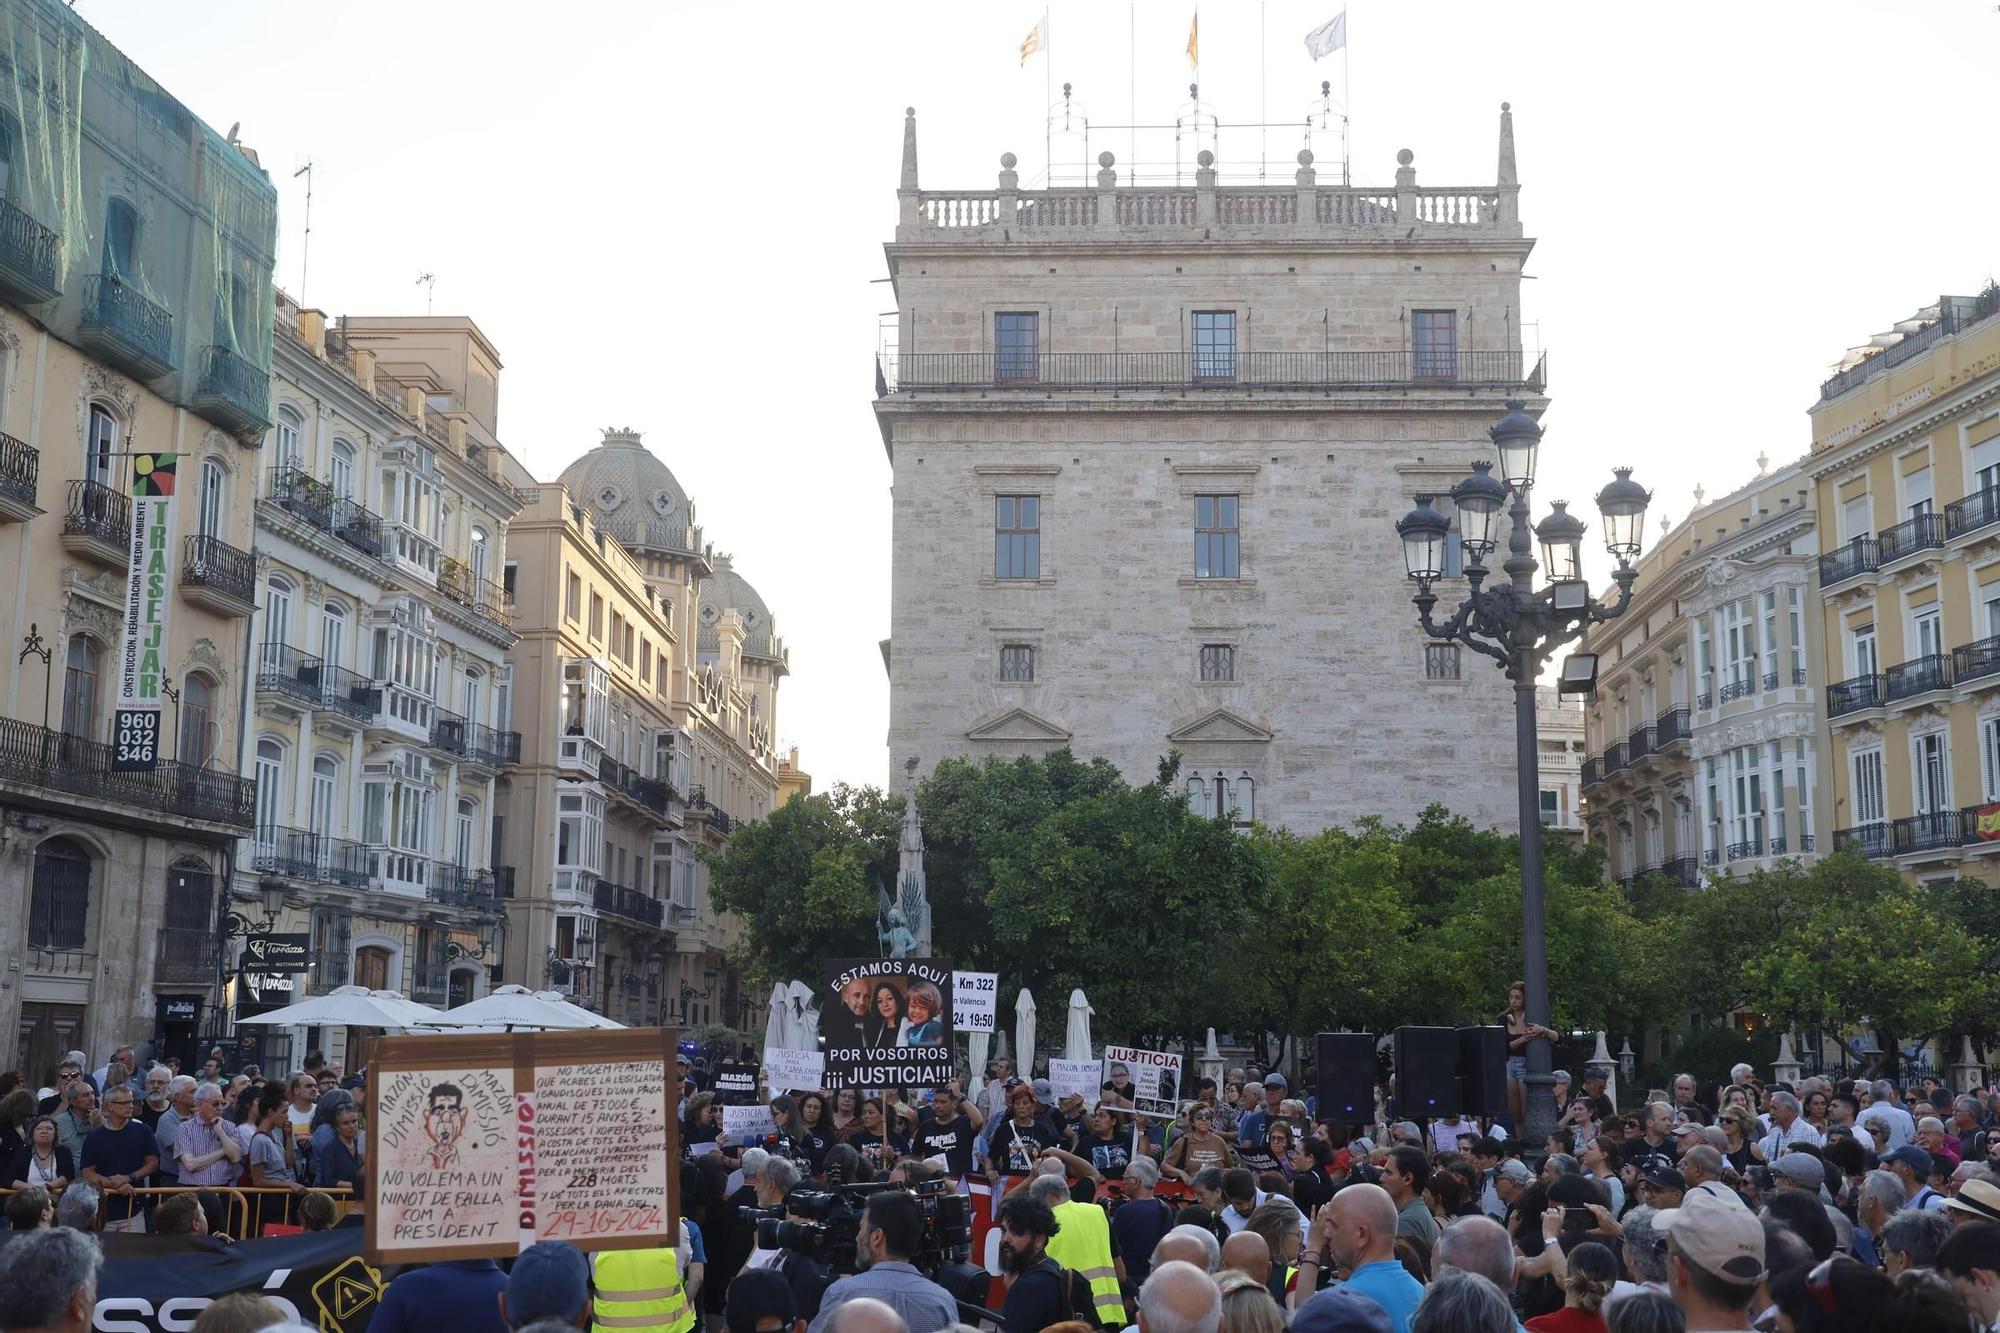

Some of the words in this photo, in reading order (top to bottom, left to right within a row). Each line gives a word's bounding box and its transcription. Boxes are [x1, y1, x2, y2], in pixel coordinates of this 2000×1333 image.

[134, 500, 146, 540] AMBIENTE
[133, 541, 144, 566] MEDIO
[132, 567, 141, 575] Y
[139, 501, 168, 698] TRASEJAR
[120, 712, 156, 729] 960
[119, 729, 154, 746] 032
[117, 745, 153, 762] 346
[266, 943, 305, 955] Terrazza
[830, 961, 902, 993] ESTAMOS
[907, 962, 949, 986] AQUÍ
[959, 977, 974, 990] Km
[976, 978, 994, 991] 322
[969, 1013, 993, 1027] 19:50
[776, 1050, 810, 1061] JUSTICIA
[830, 1049, 861, 1061] POR
[866, 1047, 948, 1061] VOSOTROS
[1107, 1048, 1180, 1069] JUSTICIA
[557, 1065, 572, 1076] NO
[576, 1064, 612, 1076] PODEM
[848, 1065, 952, 1085] JUSTICIA!!!
[536, 1077, 555, 1089] QUE
[559, 1075, 596, 1086] ACABES
[600, 1075, 611, 1085] LA
[720, 1073, 753, 1082] MAZÓN
[480, 1069, 514, 1115] MAZÓN
[637, 1084, 662, 1095] PAGA
[715, 1081, 756, 1091] DIMISSIÓ
[379, 1072, 413, 1115] MAZÓN
[536, 1101, 568, 1111] ANUAL
[574, 1101, 587, 1110] DE
[536, 1113, 578, 1124] DURANT
[580, 1112, 593, 1124] 15
[730, 1109, 763, 1118] JUSTICIA
[536, 1126, 585, 1137] ASSESORS
[575, 1136, 589, 1147] DE
[591, 1135, 613, 1145] TOTS
[617, 1134, 639, 1144] ELS
[517, 1094, 537, 1230] DIMISSIÓ
[571, 1156, 590, 1166] ELS
[594, 1153, 649, 1164] PERMETREM
[538, 1168, 555, 1178] PER
[557, 1167, 571, 1177] LA
[620, 1163, 648, 1174] DELS
[382, 1170, 404, 1187] NO
[410, 1171, 462, 1188] VOLEM
[466, 1172, 478, 1186] A
[481, 1172, 503, 1187] UN
[567, 1173, 598, 1188] 228
[600, 1174, 638, 1186] MORTS
[567, 1189, 589, 1199] TOTS
[591, 1187, 611, 1199] ELS
[614, 1185, 665, 1197] AFECTATS
[381, 1191, 430, 1206] NINOT
[431, 1191, 453, 1206] DE
[454, 1191, 503, 1208] FALLA
[555, 1199, 576, 1210] PER
[577, 1199, 591, 1210] LA
[593, 1198, 624, 1210] DANA
[402, 1208, 433, 1222] COM
[443, 1208, 454, 1221] A
[542, 1207, 664, 1237] 29-10-2024
[394, 1221, 499, 1240] PRESIDENT
